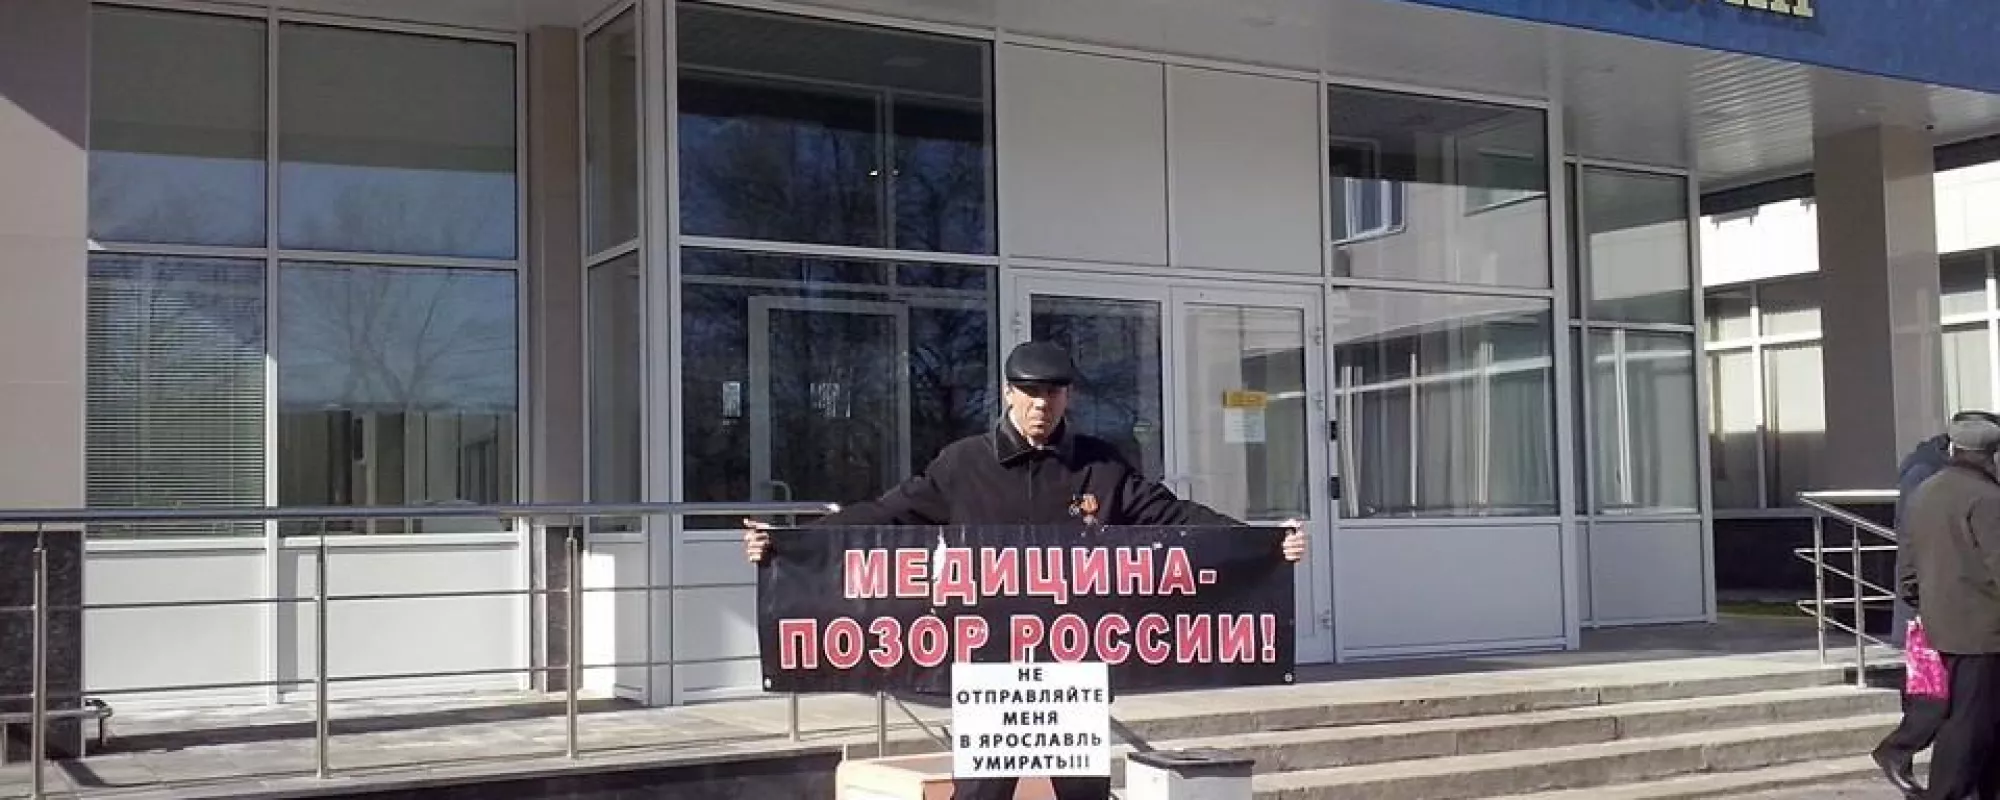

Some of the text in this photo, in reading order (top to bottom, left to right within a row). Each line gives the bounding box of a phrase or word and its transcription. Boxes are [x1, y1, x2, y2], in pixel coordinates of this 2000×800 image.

[844, 546, 1218, 606] МЕДИЦИНА-
[778, 612, 1277, 669] ПОЗОР РОССИИ!
[1018, 667, 1043, 682] НЕ
[956, 685, 1104, 705] ОТПРАВЛЯЙТЕ
[1003, 711, 1058, 726] МЕНЯ
[960, 732, 1101, 749] В ЯРОСЛАВЛЬ
[972, 754, 1090, 771] УМИРАТЬ!!!
